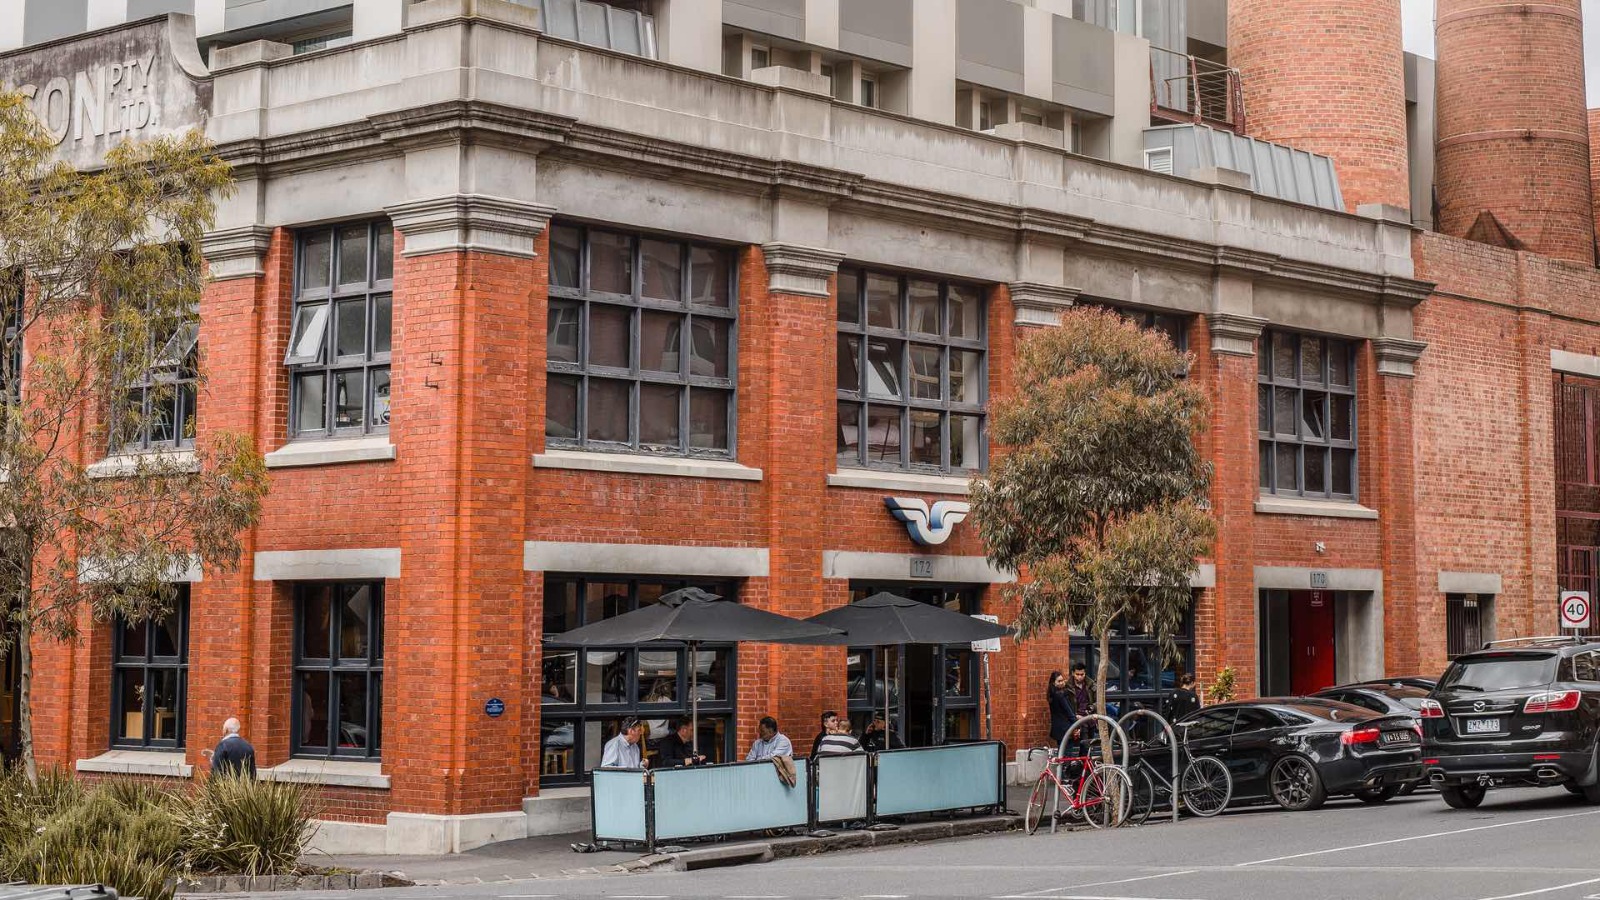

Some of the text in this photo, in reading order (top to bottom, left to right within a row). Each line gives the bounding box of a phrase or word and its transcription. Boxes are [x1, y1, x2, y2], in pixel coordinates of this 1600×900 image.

[111, 51, 156, 95] PTY
[108, 98, 156, 134] LTD.
[913, 560, 931, 574] 172
[1313, 573, 1325, 584] 170
[1567, 603, 1584, 615] 40
